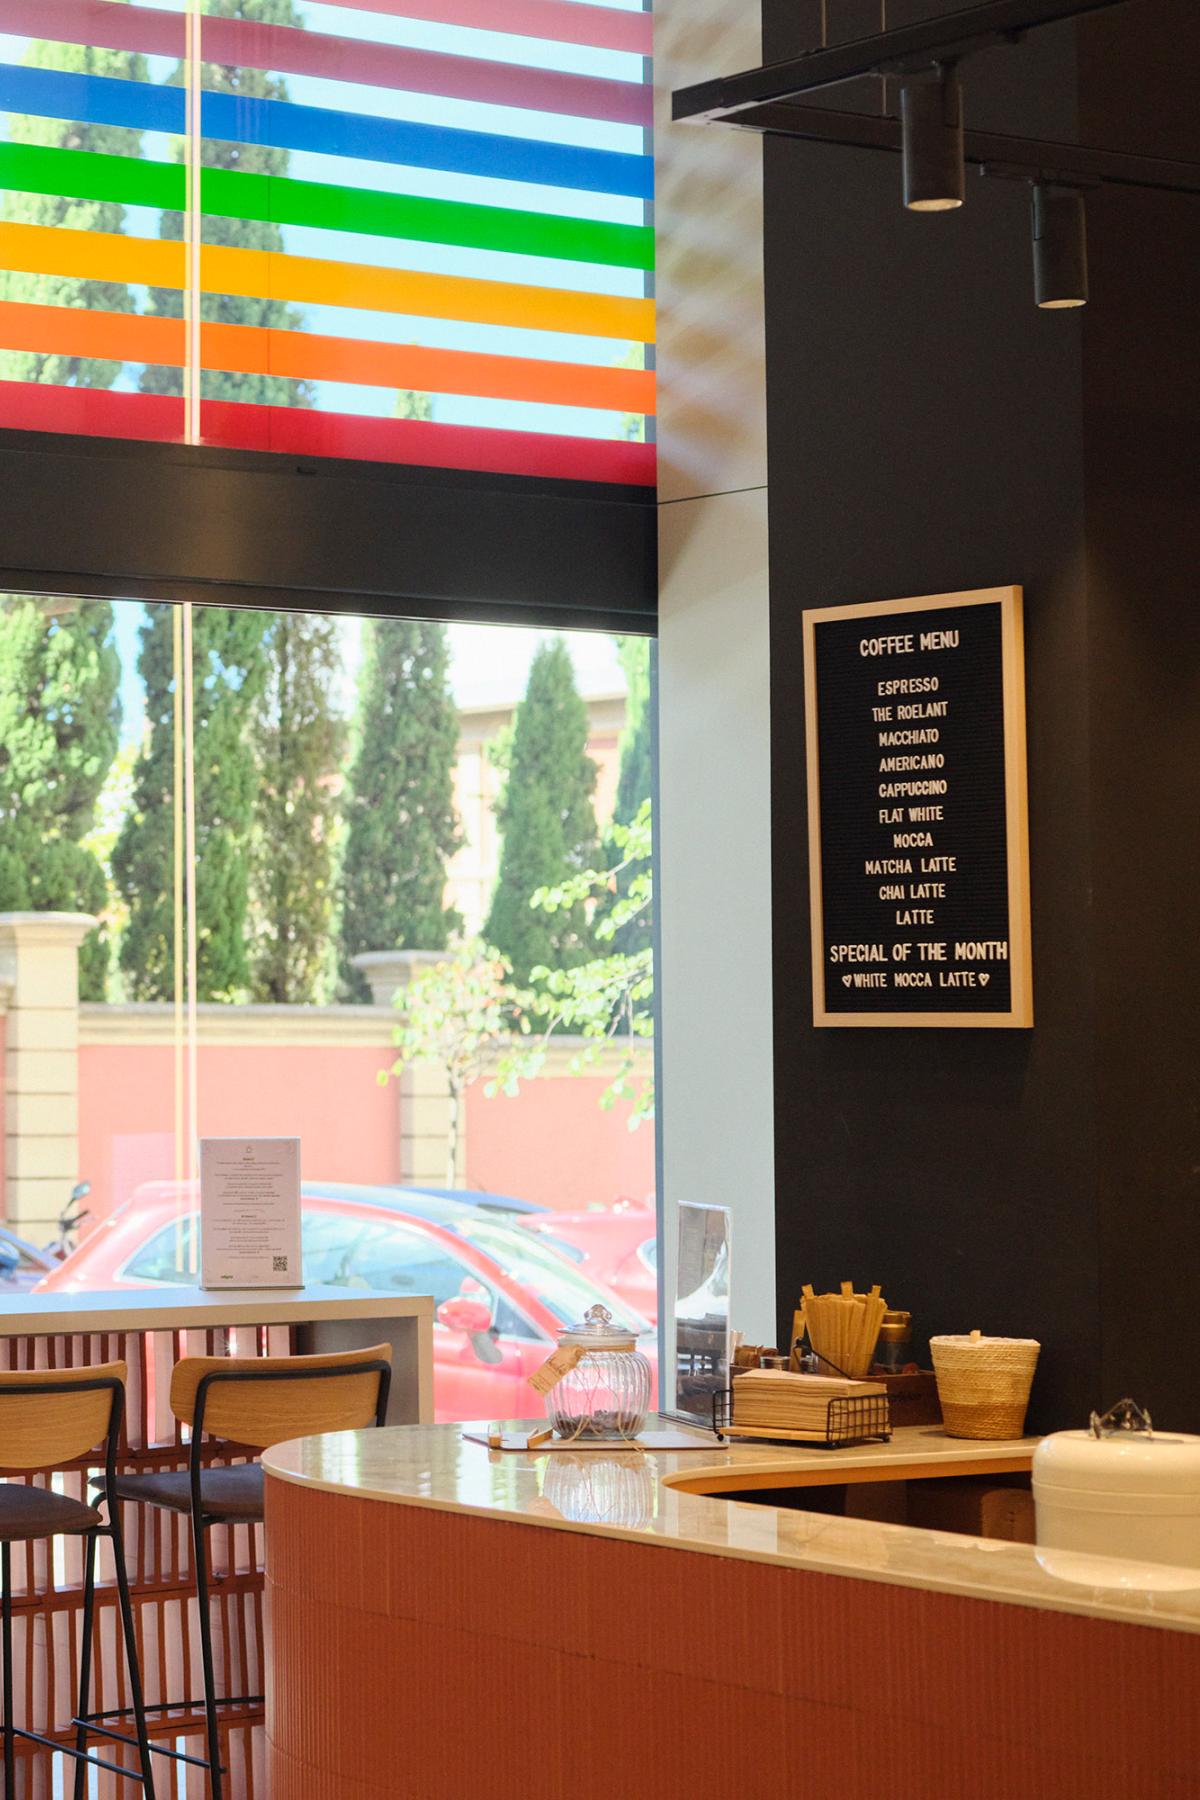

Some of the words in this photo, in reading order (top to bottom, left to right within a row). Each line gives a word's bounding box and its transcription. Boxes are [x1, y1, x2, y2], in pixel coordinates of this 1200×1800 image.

[860, 635, 914, 656] COFFEE
[920, 630, 959, 650] MENU
[878, 677, 938, 695] ESPRESSO
[872, 707, 892, 721] THE
[898, 701, 948, 719] ROELANT
[879, 729, 939, 746] MACCHIATO
[879, 754, 944, 772] AMERICANO
[879, 780, 947, 797] CAPPUCCINO
[879, 808, 904, 823] FLAT
[909, 806, 943, 821] WHITE
[894, 833, 933, 848] MOCCA
[866, 859, 912, 874] MATCHA
[921, 857, 956, 872] LATTE
[879, 885, 904, 900] CHAI
[911, 883, 945, 898] LATTE
[897, 910, 934, 925] LATTE
[830, 945, 888, 962] SPECIAL
[893, 943, 912, 961] OF
[917, 943, 947, 960] THE
[955, 941, 1007, 960] MONTH
[854, 973, 887, 987] WHITE
[894, 973, 932, 986] MOCCA
[940, 972, 976, 986] LATTE
